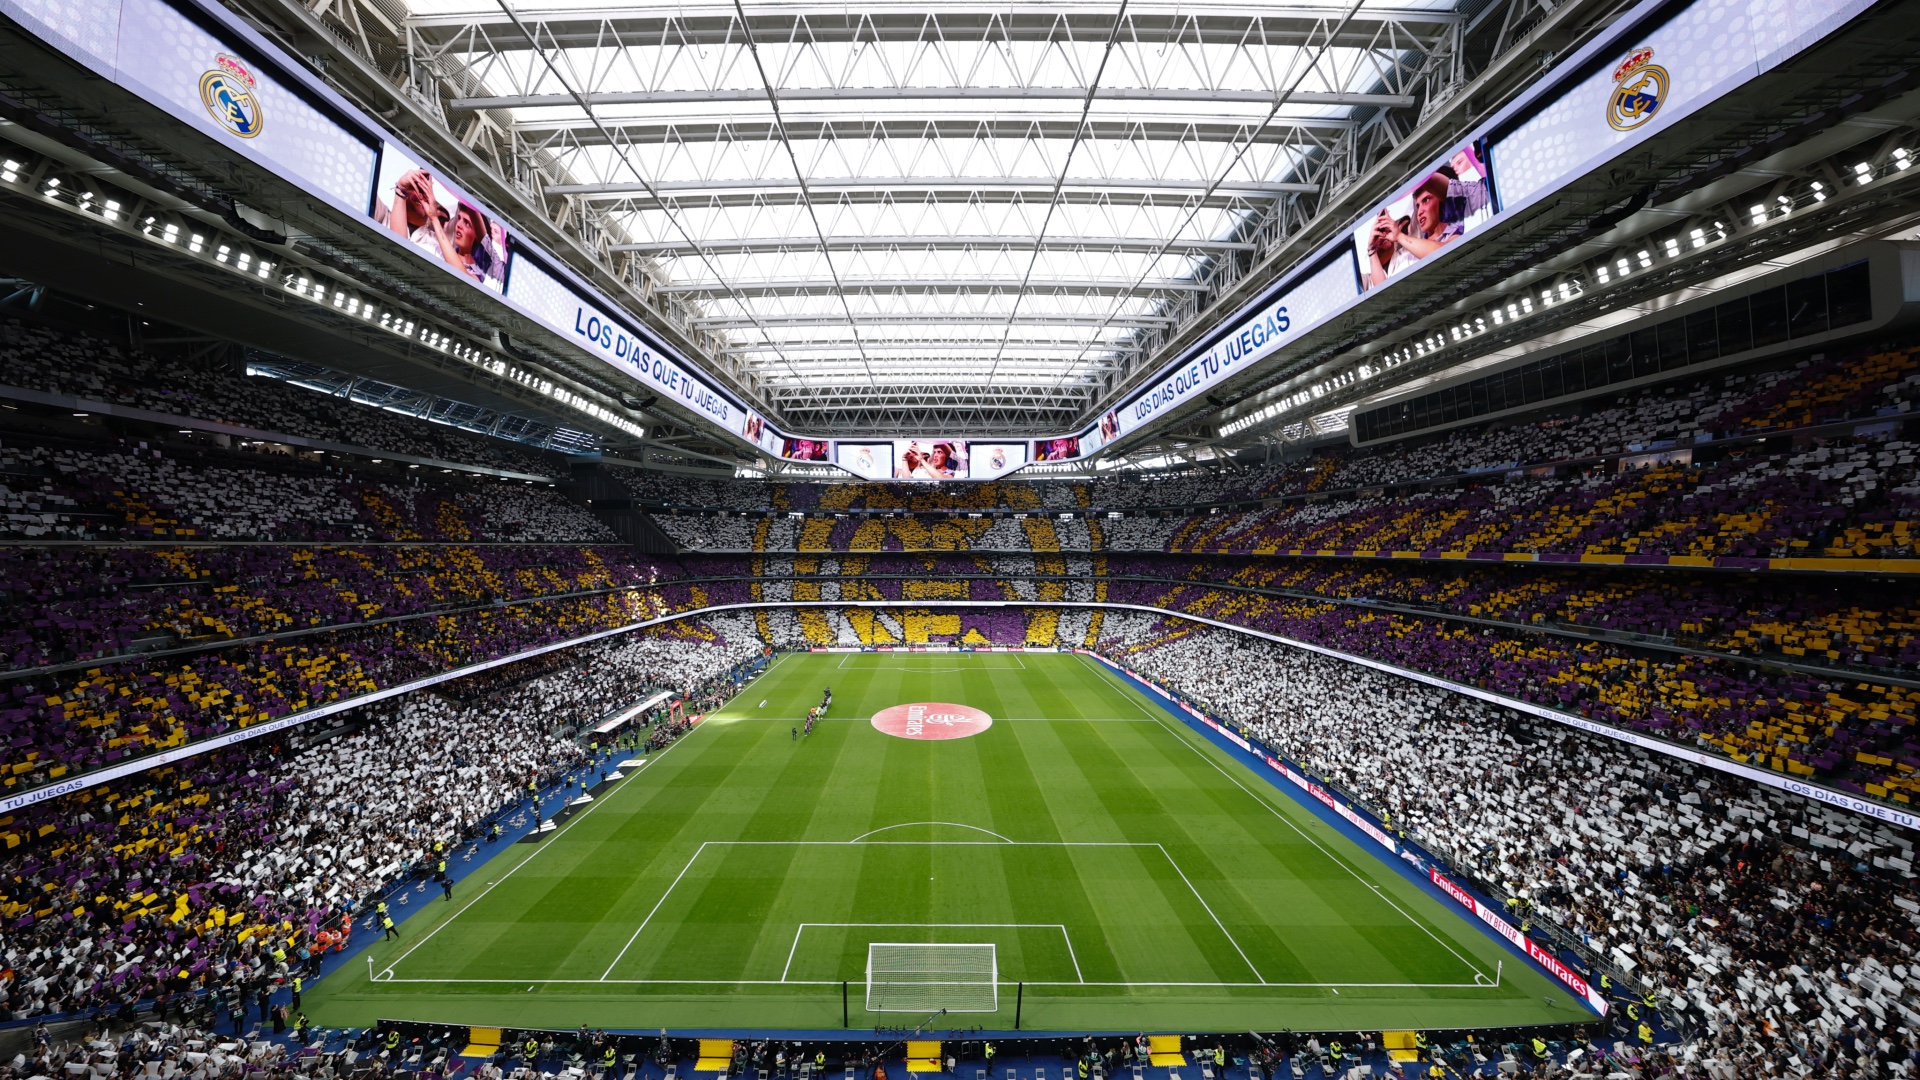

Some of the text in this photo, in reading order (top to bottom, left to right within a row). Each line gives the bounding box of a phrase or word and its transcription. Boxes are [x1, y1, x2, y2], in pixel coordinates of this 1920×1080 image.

[575, 307, 728, 420] LOS DÍAS QUE TÚ JUEGAS
[1135, 306, 1290, 420] LOS DÍAS QUE TÚ JUEGAS
[229, 731, 246, 743] LOS
[269, 721, 286, 731] QUE
[297, 710, 325, 723] JUEGAS
[906, 705, 927, 736] Emirates
[1538, 709, 1553, 718] LOS
[1572, 719, 1588, 729] QUE
[1602, 728, 1637, 743] JUEGAS
[4, 780, 83, 809] TÚ JUEGAS
[1310, 784, 1333, 807] Emirates
[1783, 780, 1811, 795] LOS
[1815, 790, 1848, 806] DÍAS
[1853, 802, 1886, 818] QUE
[1433, 872, 1473, 909] Emirates
[1483, 909, 1517, 943] FLY BETTER
[1530, 942, 1587, 997] Emirates
